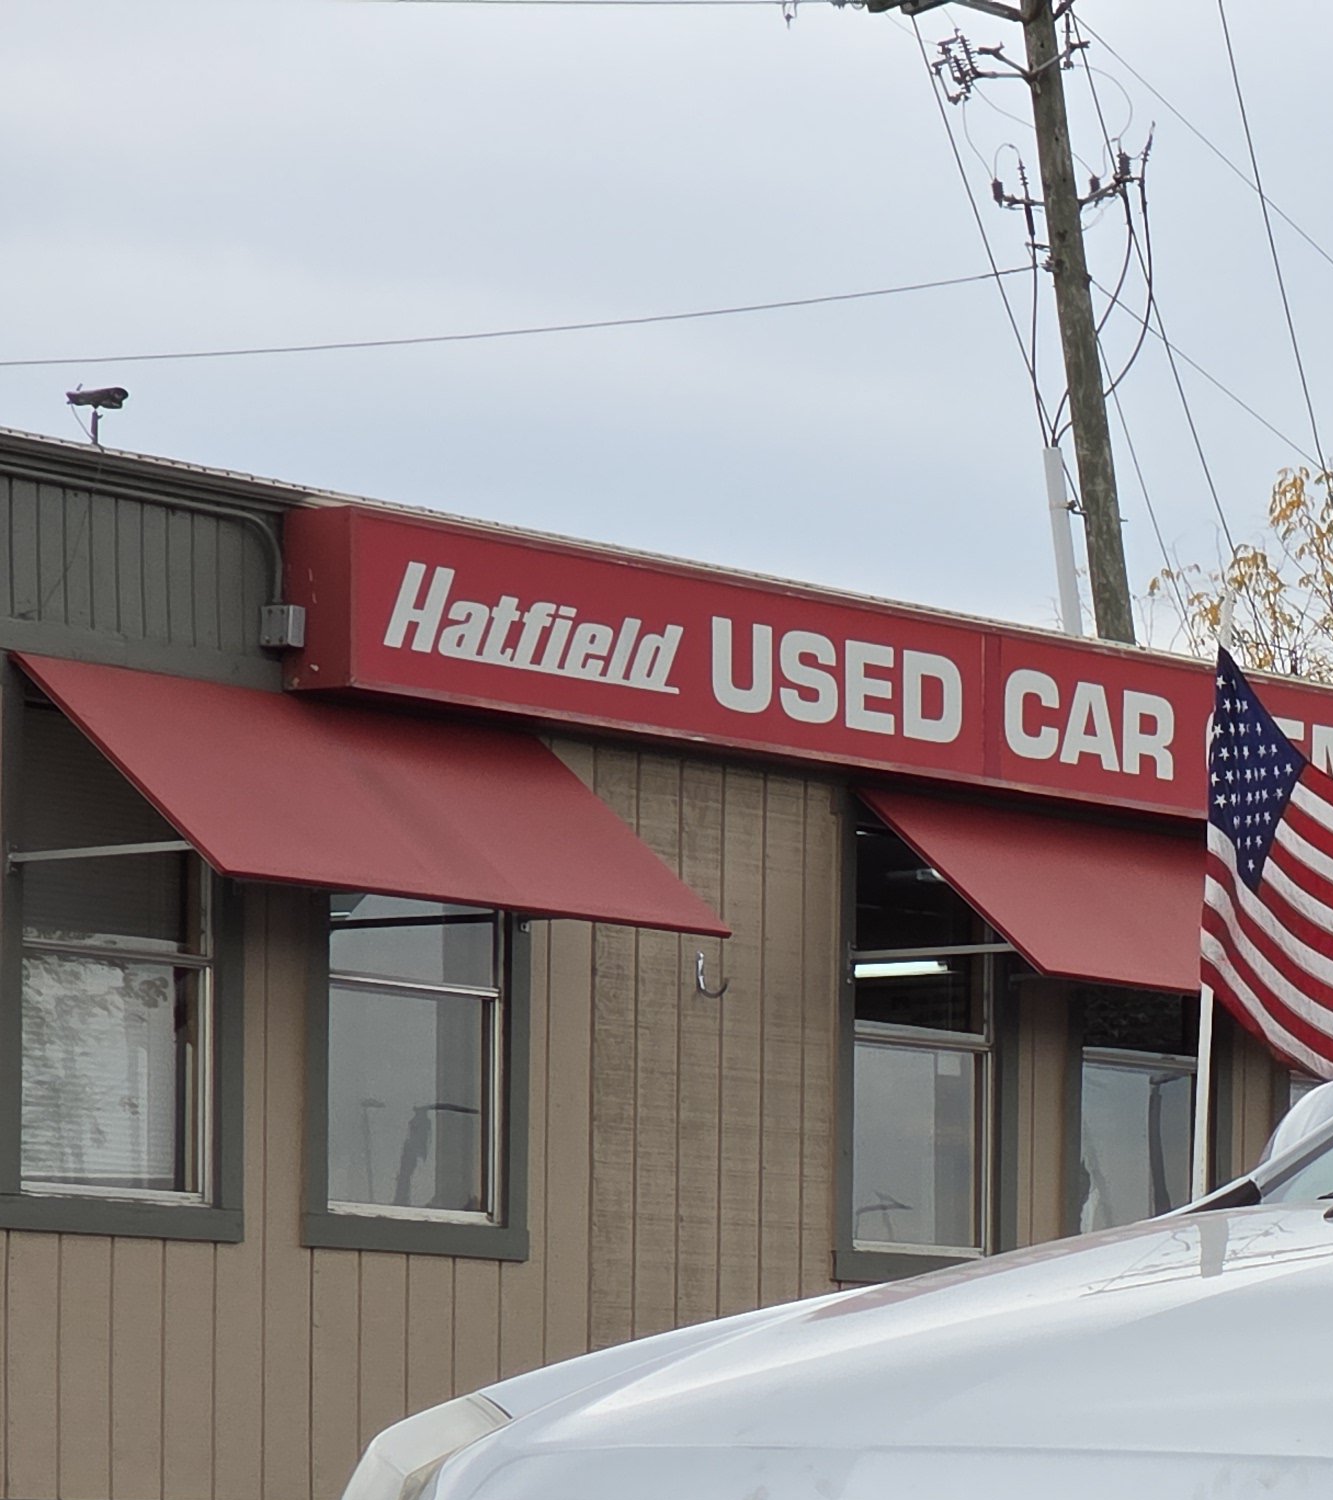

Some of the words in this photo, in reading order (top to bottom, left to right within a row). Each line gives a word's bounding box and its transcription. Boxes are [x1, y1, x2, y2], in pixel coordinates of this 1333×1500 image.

[383, 561, 683, 694] Hatfield
[711, 616, 963, 743] USED
[1004, 668, 1175, 781] CAR
